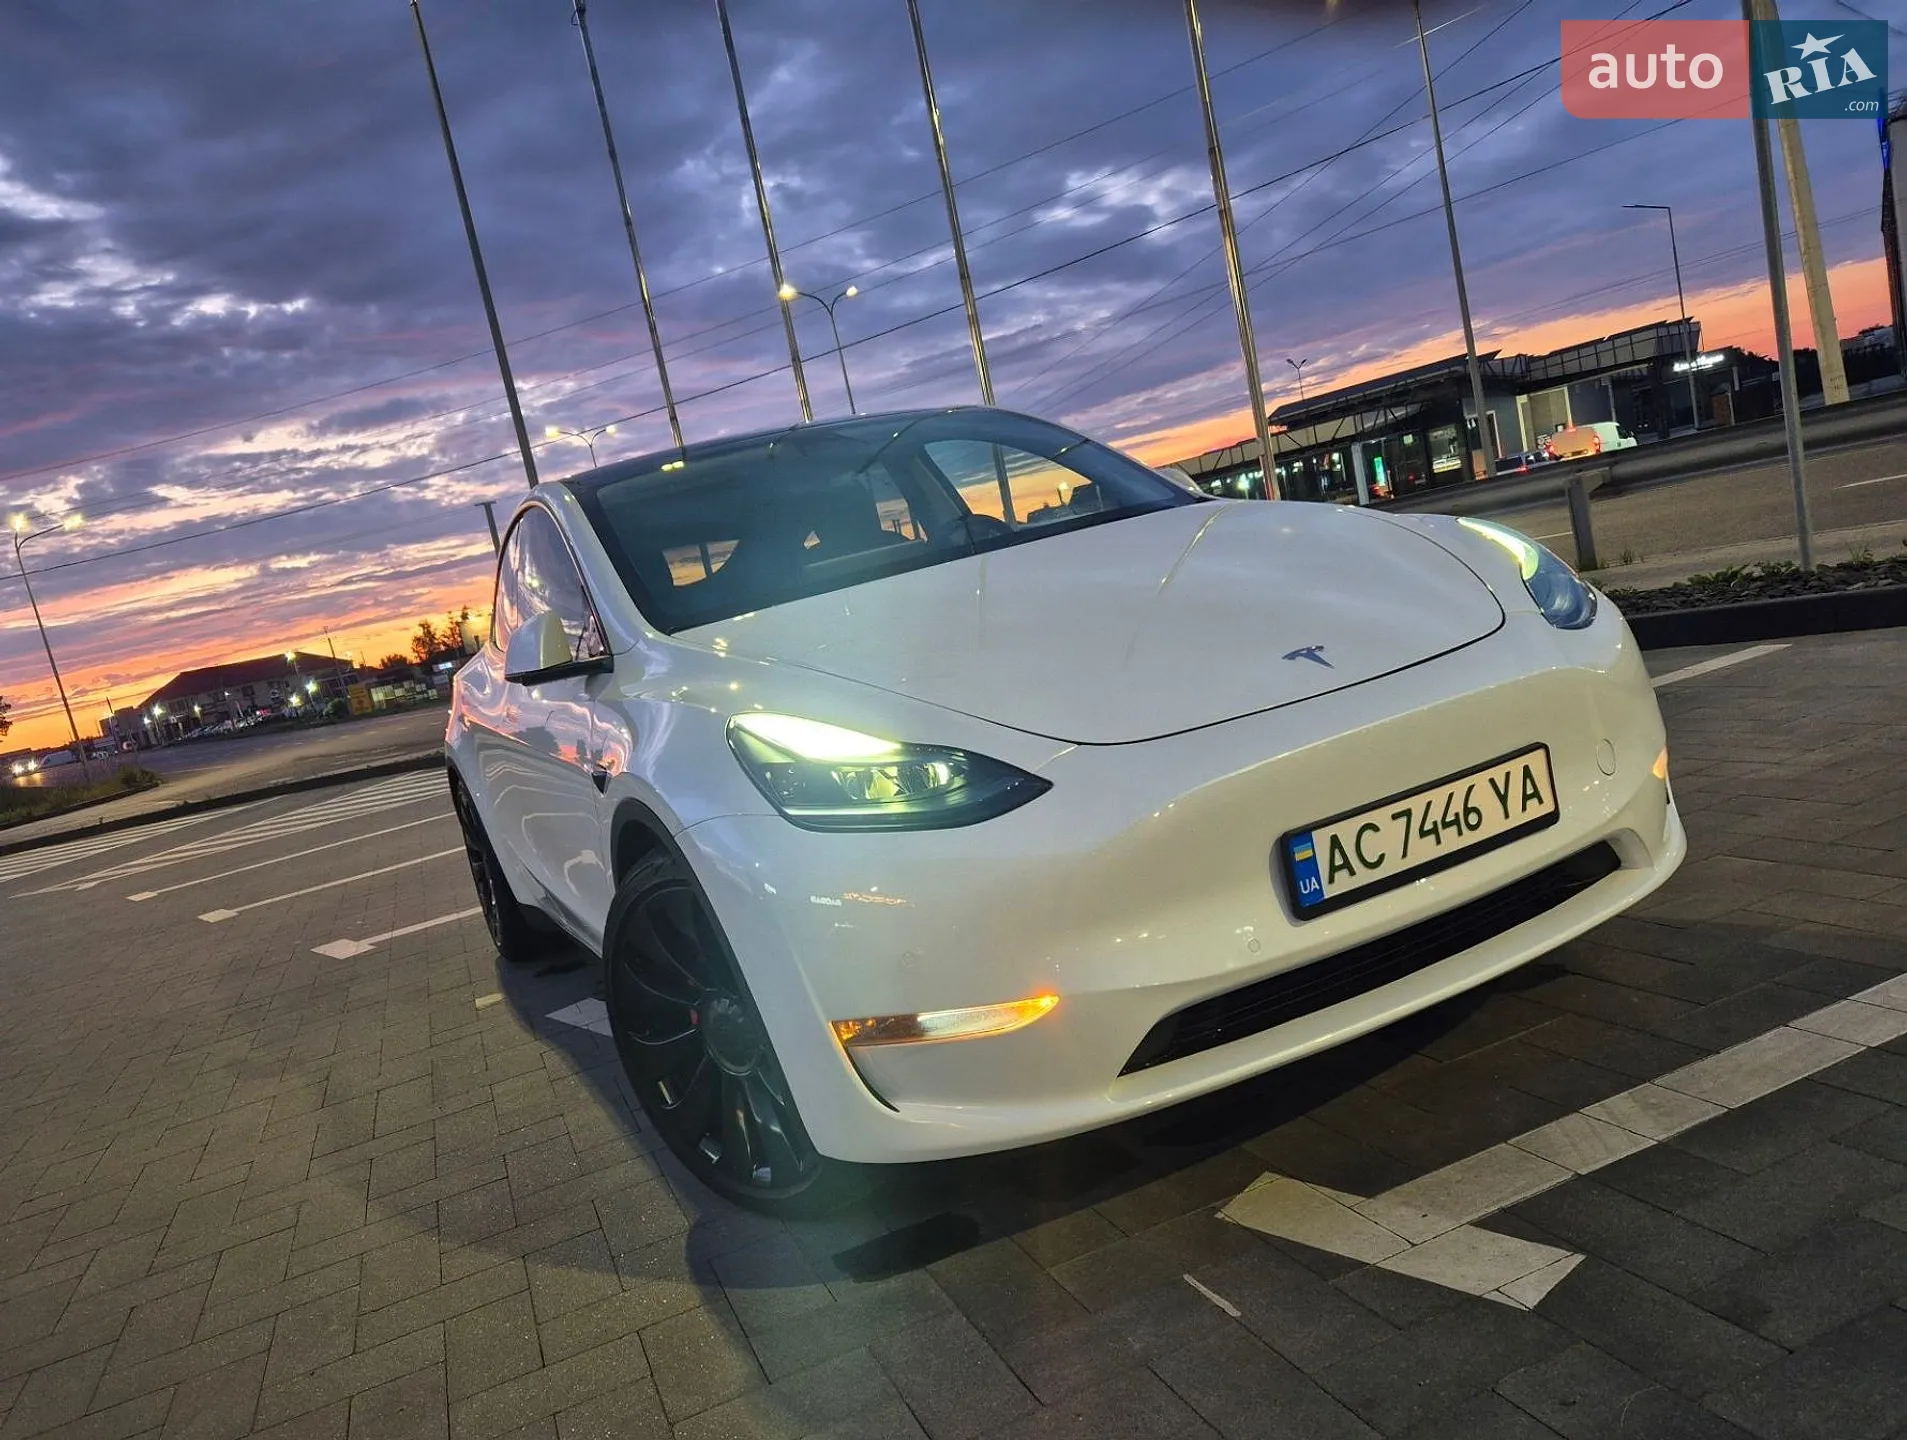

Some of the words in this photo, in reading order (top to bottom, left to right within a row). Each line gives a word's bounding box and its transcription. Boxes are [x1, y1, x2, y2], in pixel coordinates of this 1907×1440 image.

[1328, 822, 1386, 884] AC
[1390, 783, 1483, 860] 7446
[1488, 764, 1544, 820] YA
[1300, 876, 1320, 895] UA
